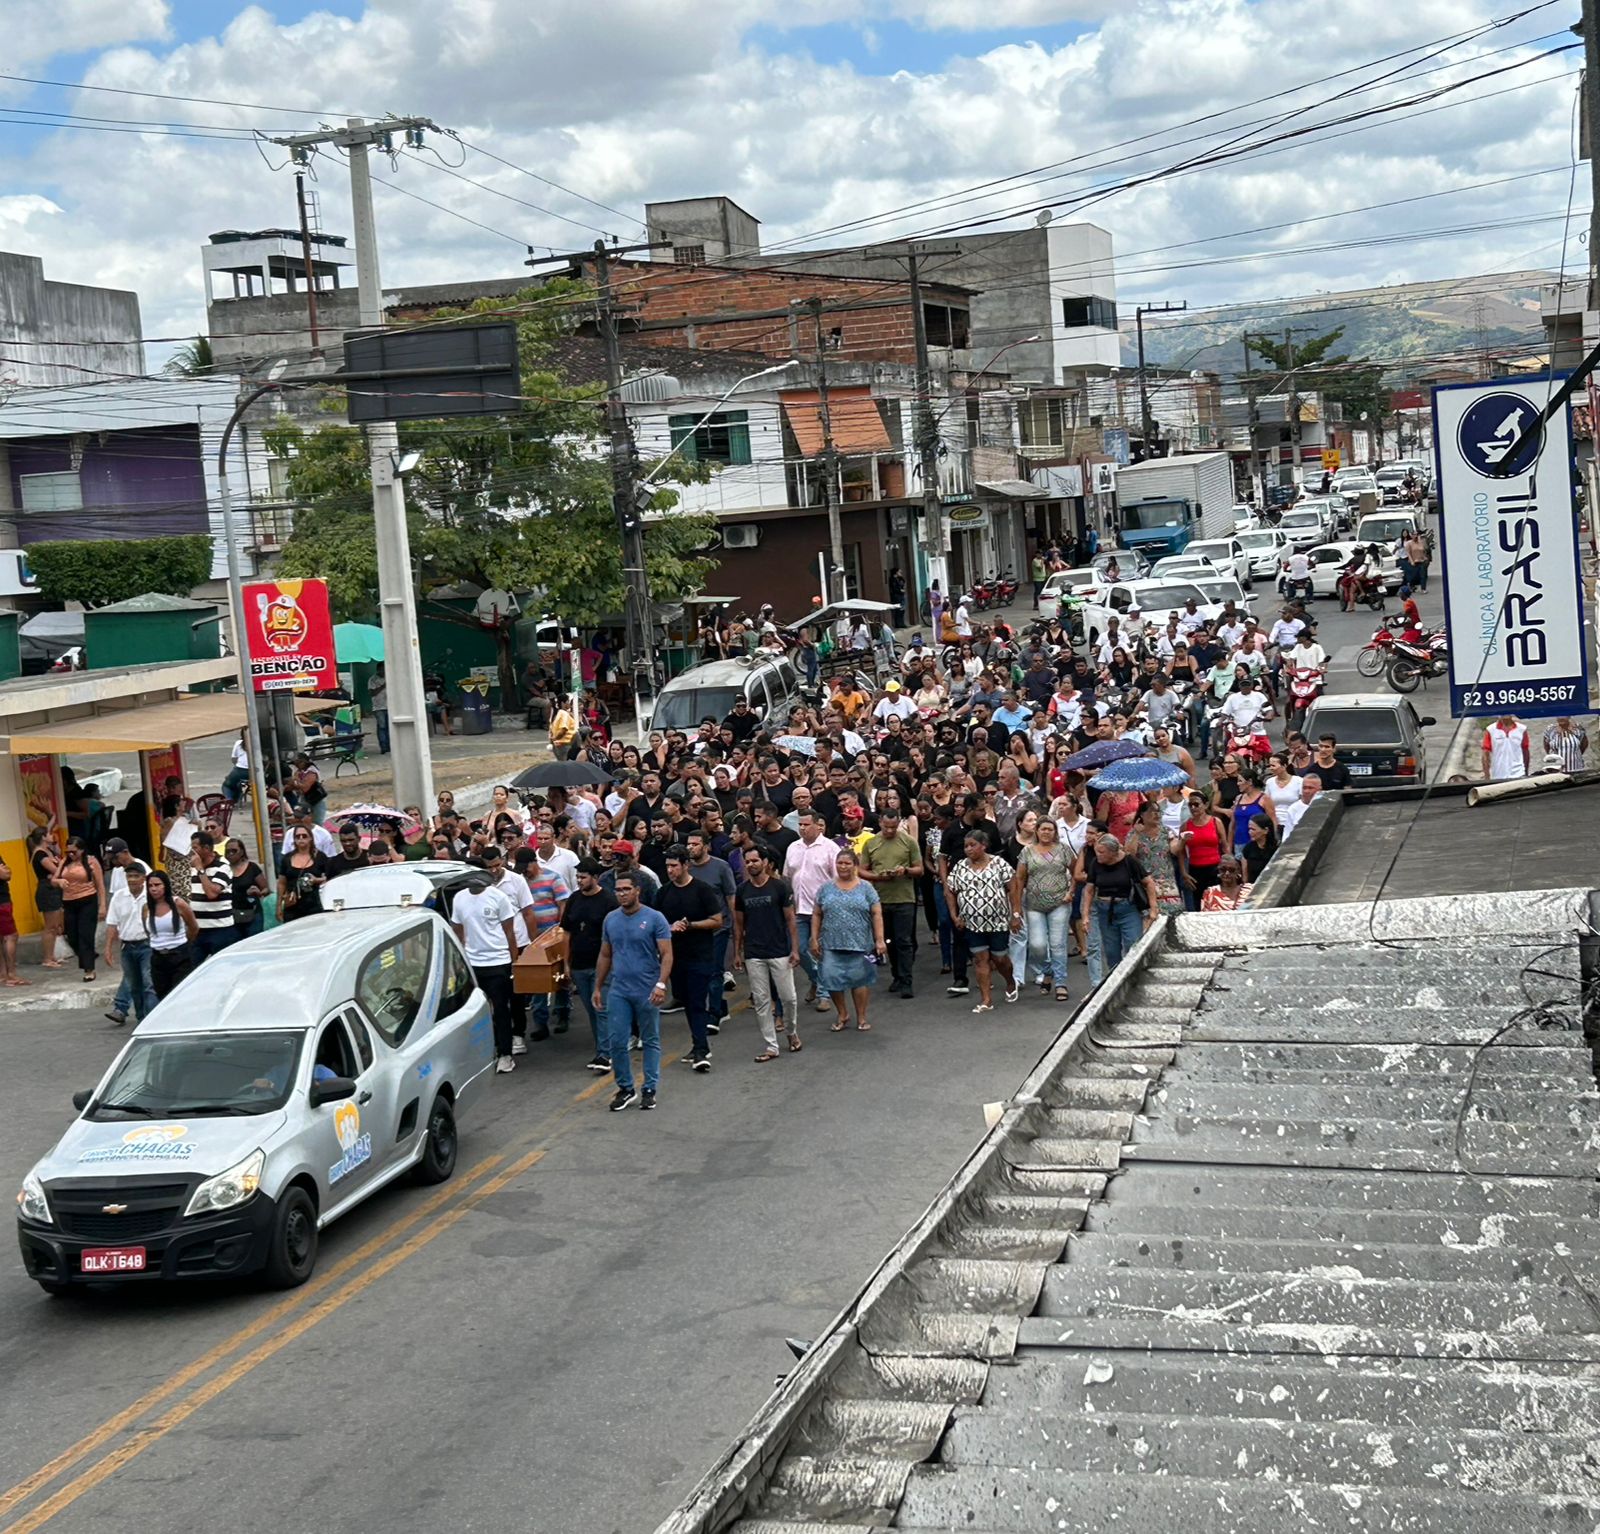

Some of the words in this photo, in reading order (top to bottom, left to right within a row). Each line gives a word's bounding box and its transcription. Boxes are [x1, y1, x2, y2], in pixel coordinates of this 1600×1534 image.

[1472, 492, 1493, 587] LABORATÓRIO
[1497, 475, 1547, 667] BRASIL
[1480, 591, 1494, 600] &
[1479, 602, 1497, 656] CLÍNICA
[250, 657, 326, 675] BENÇÃO
[1463, 692, 1482, 706] 82
[1485, 685, 1576, 706] 9.9649-5567
[120, 1143, 197, 1155] CHAGAS
